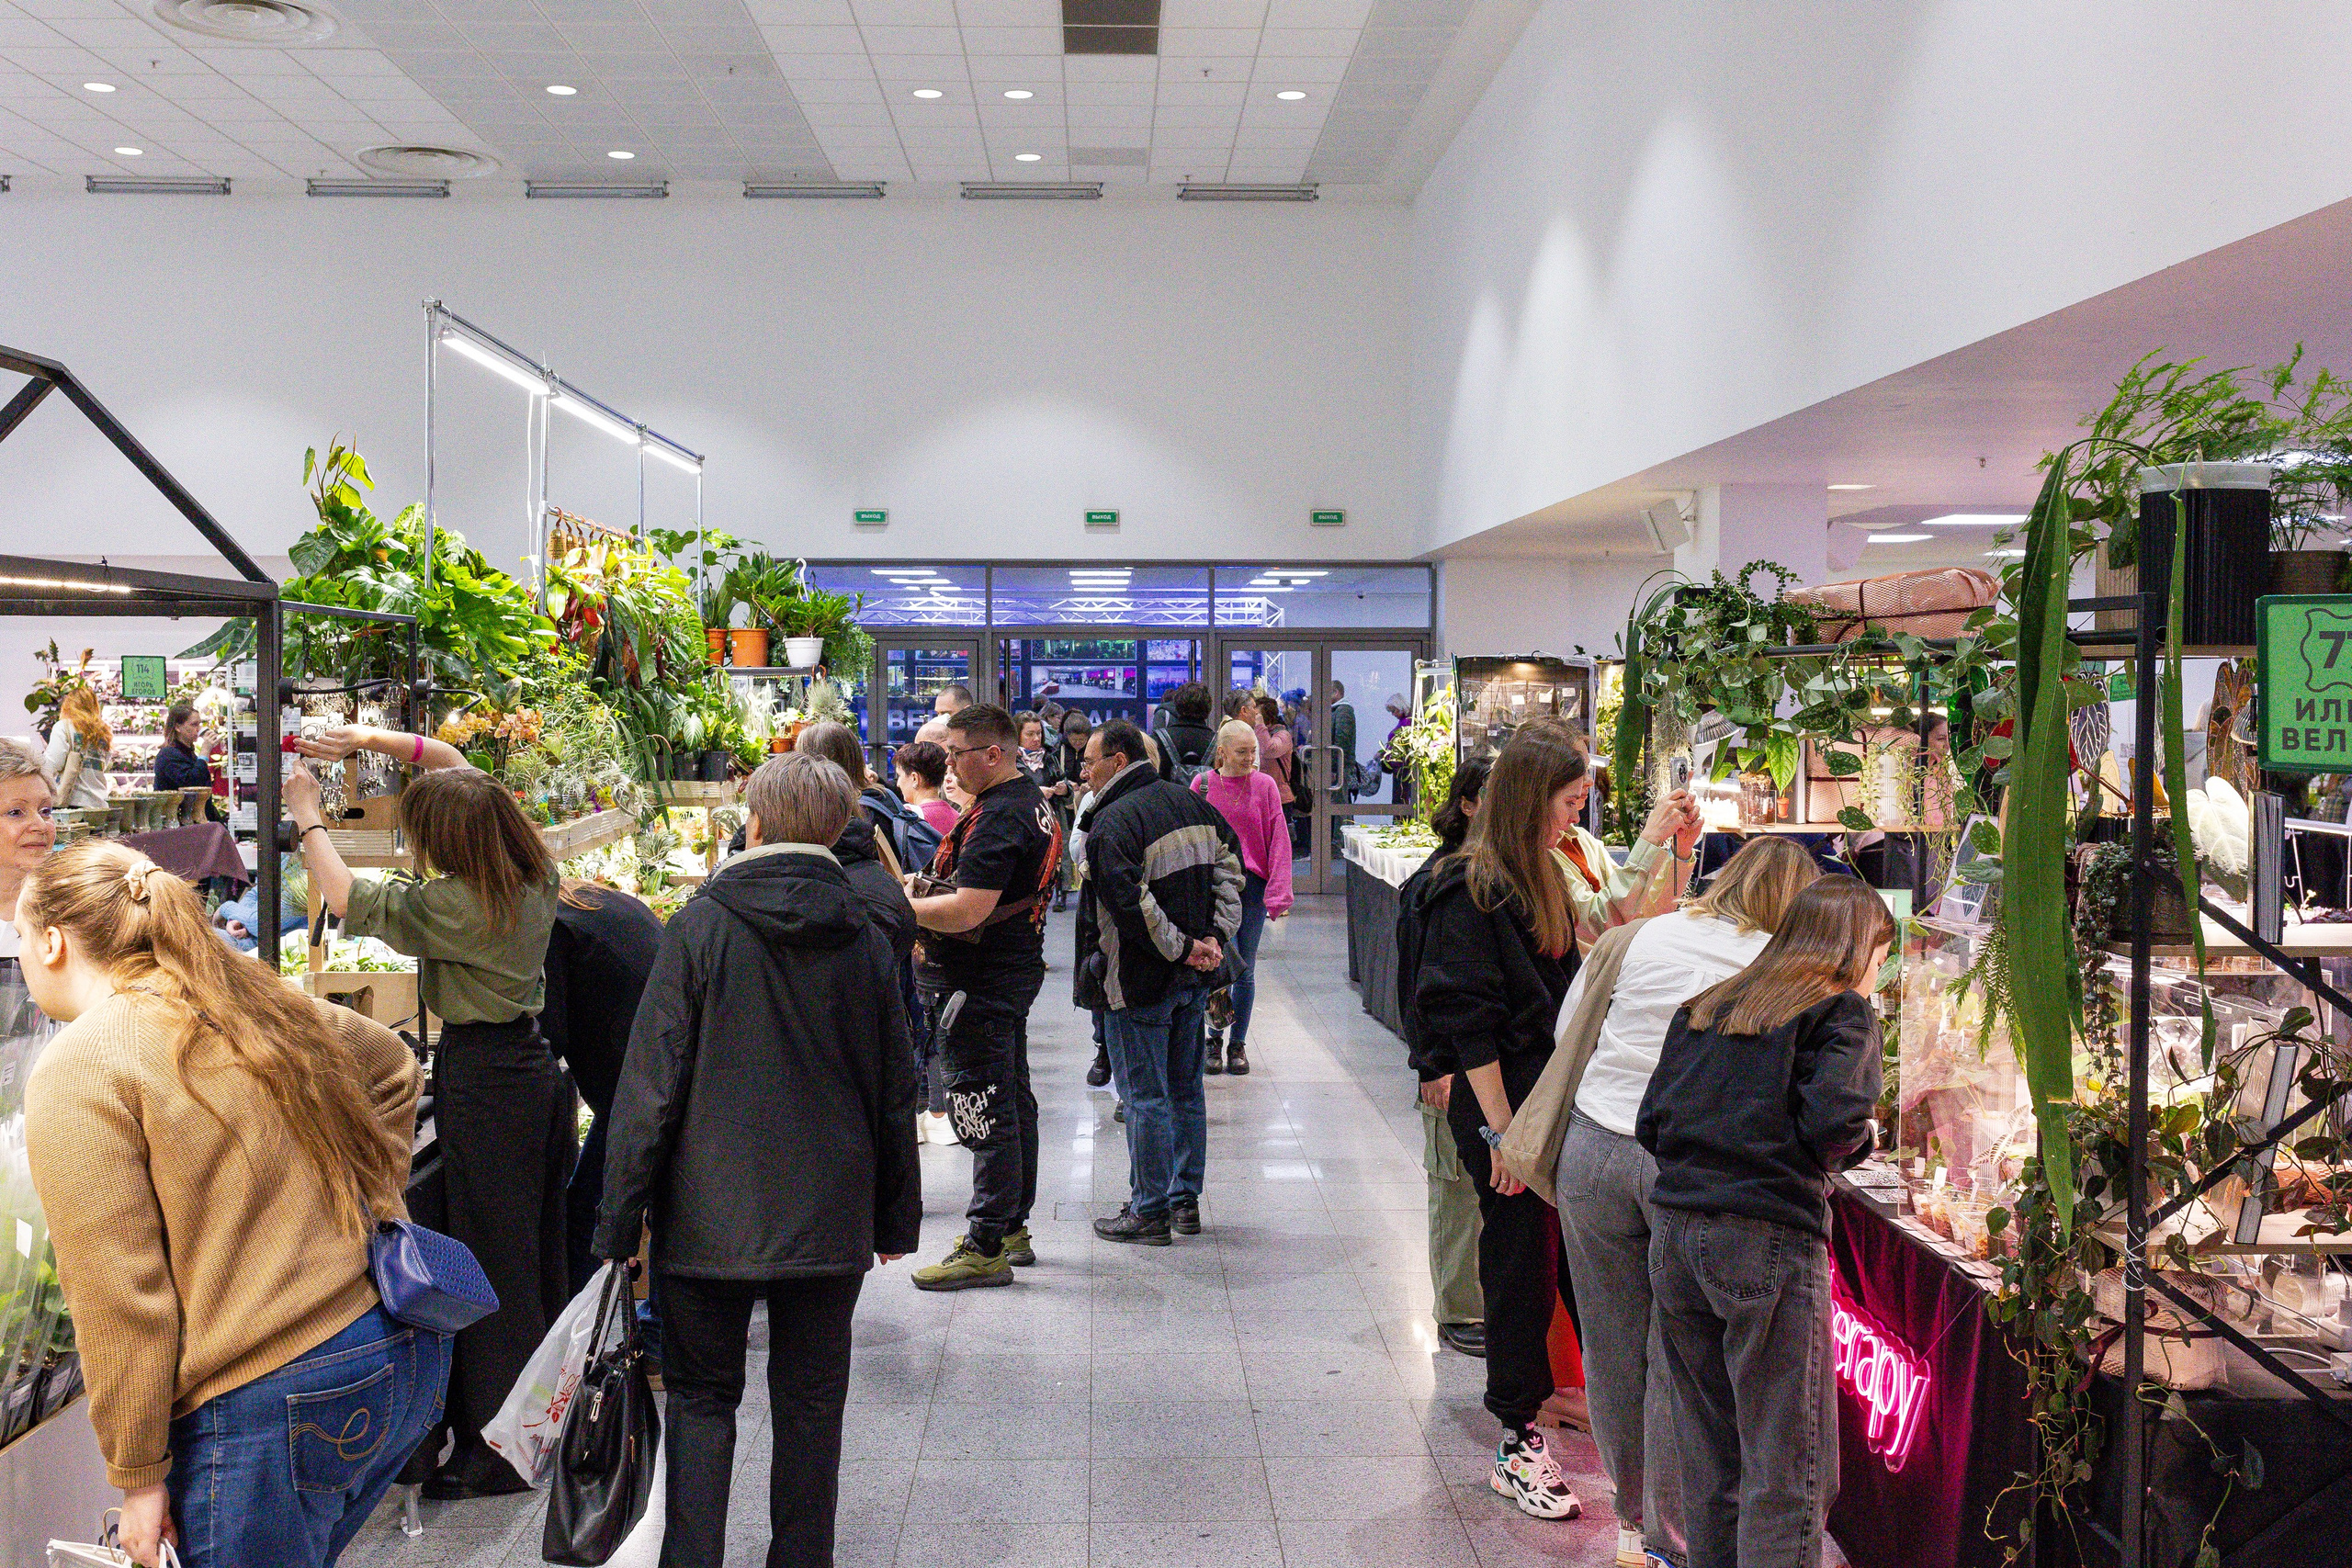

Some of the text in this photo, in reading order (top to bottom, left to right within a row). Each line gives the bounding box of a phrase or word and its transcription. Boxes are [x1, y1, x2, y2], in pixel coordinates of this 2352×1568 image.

[2319, 630, 2352, 669] 7
[136, 663, 150, 673] 114
[2281, 727, 2346, 752] ВЕЛ
[1831, 1309, 1928, 1456] erapy
